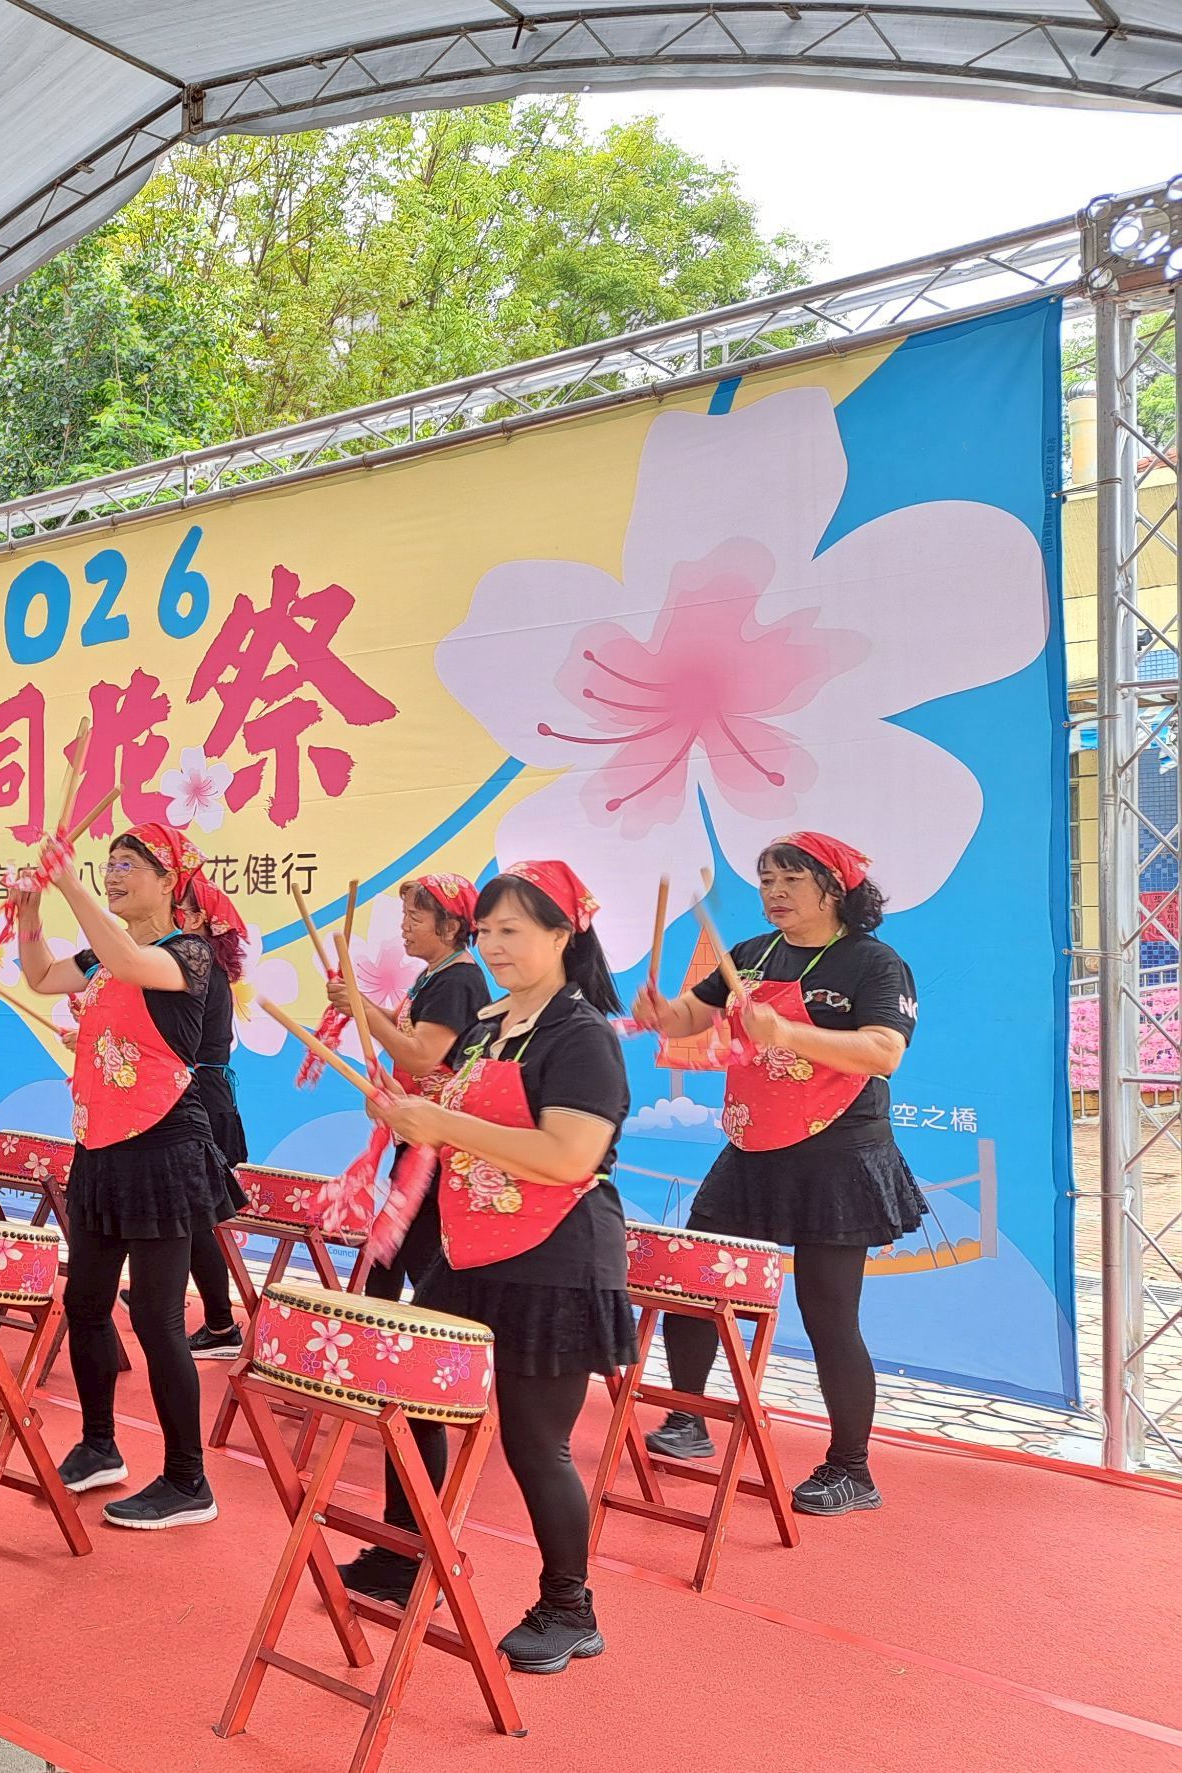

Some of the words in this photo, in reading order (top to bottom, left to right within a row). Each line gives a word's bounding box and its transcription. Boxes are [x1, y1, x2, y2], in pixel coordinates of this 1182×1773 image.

[892, 1103, 978, 1133] 空之橋
[328, 1246, 357, 1258] Council
